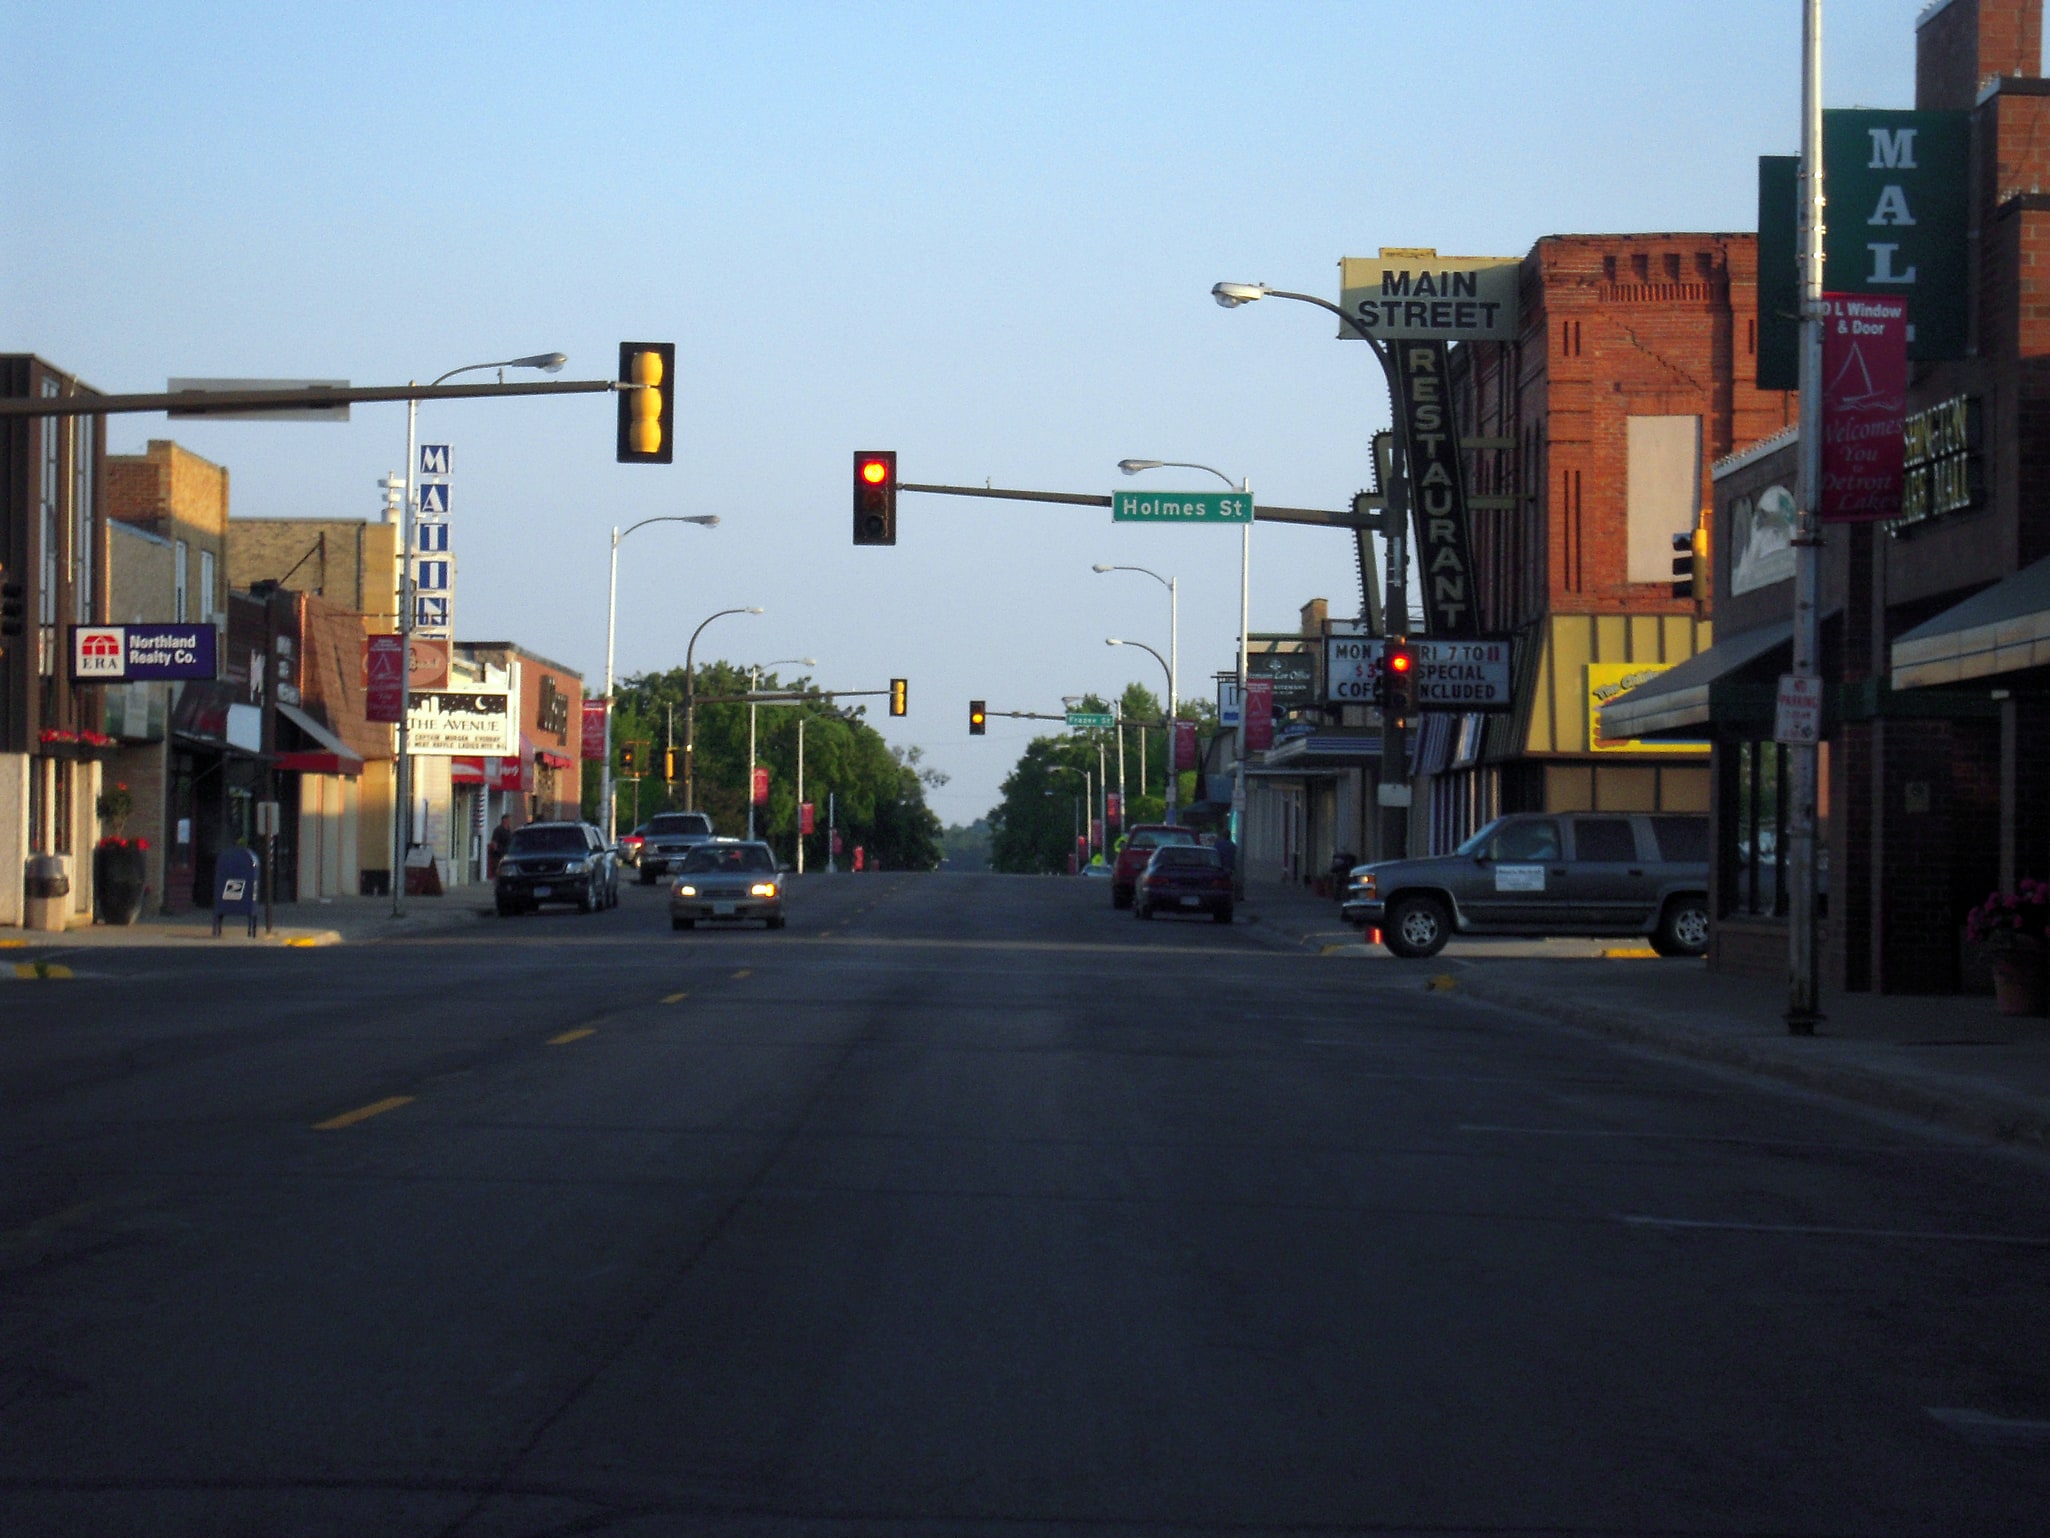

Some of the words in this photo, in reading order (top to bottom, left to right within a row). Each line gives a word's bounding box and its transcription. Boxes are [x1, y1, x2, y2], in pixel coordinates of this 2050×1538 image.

[1866, 128, 1917, 341] MAL
[1382, 270, 1477, 297] MAIN
[1357, 300, 1501, 328] STREET
[1835, 302, 1844, 316] L
[1847, 302, 1902, 318] Window
[1837, 320, 1848, 334] &
[1852, 320, 1885, 335] Door
[1841, 445, 1879, 462] You
[1409, 349, 1465, 628] RESTAURANT
[1123, 499, 1206, 516] Holmes
[1220, 500, 1242, 516] St
[129, 634, 196, 649] Northland
[129, 650, 171, 667] Realty
[174, 650, 197, 664] Co.
[1335, 645, 1372, 659] MON
[1421, 646, 1437, 660] RI
[1448, 646, 1457, 660] 7
[1464, 647, 1483, 661] TO
[82, 657, 118, 670] ERA
[1419, 664, 1486, 681] SPECIAL
[1337, 682, 1379, 697] COFF
[1420, 682, 1496, 698] NCLUDED
[409, 718, 437, 730] THE
[443, 719, 499, 732] AVENUE
